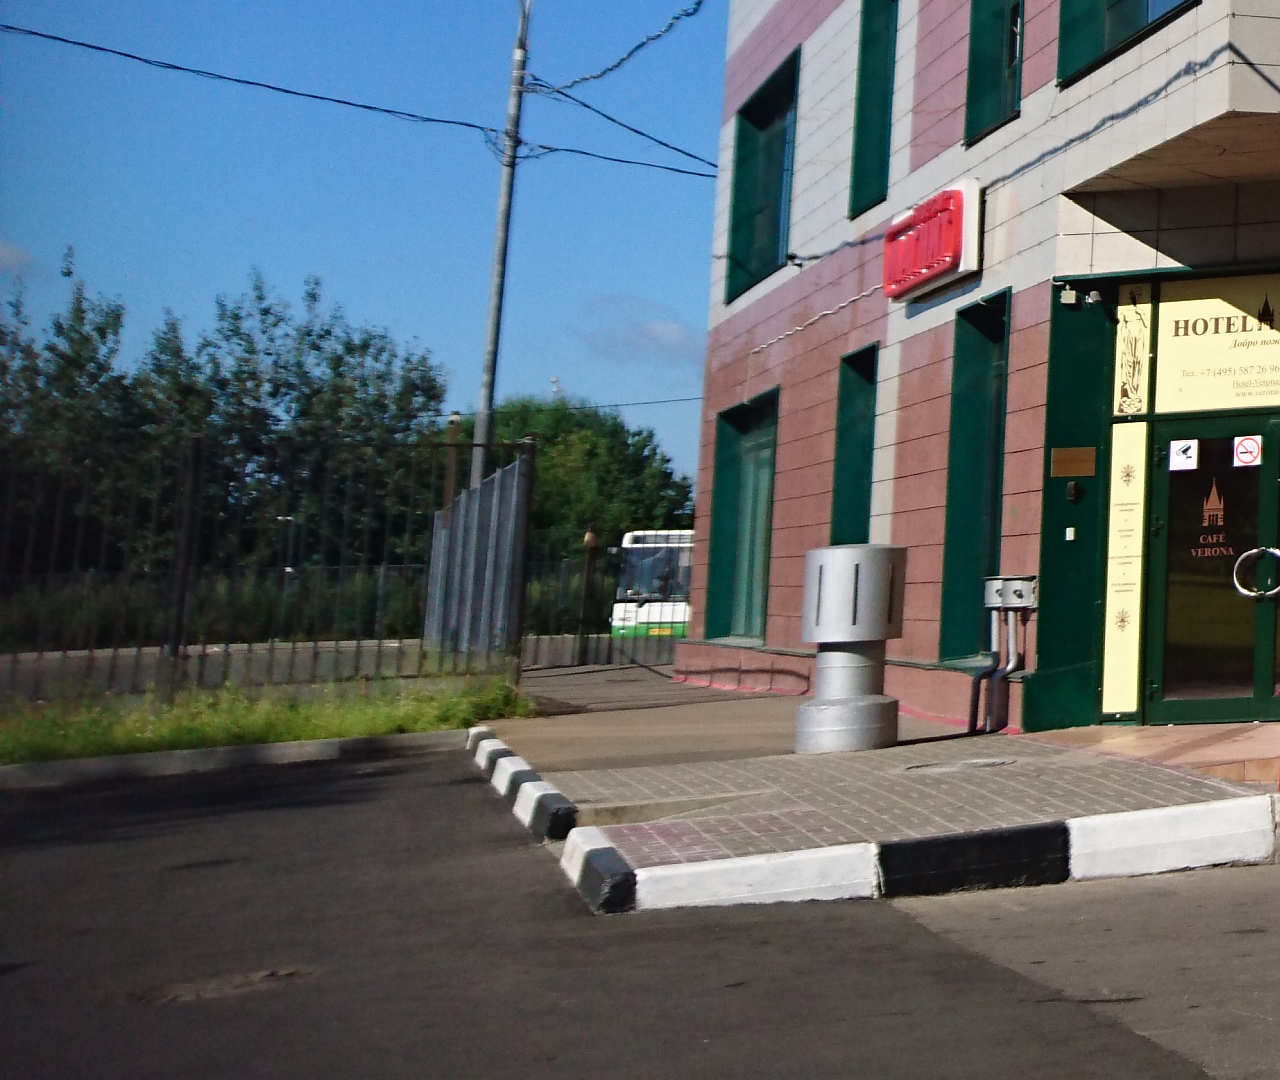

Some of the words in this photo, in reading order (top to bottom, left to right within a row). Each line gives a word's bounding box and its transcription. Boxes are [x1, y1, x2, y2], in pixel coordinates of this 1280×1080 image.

[1172, 314, 1254, 338] HOTEL
[1229, 339, 1259, 350] Добро
[1200, 368, 1212, 377] +7
[1213, 367, 1237, 379] (495)
[1238, 366, 1254, 376] 587
[1256, 365, 1268, 374] 26
[1199, 531, 1226, 544] CAFÉ
[1190, 546, 1235, 558] VERONA
